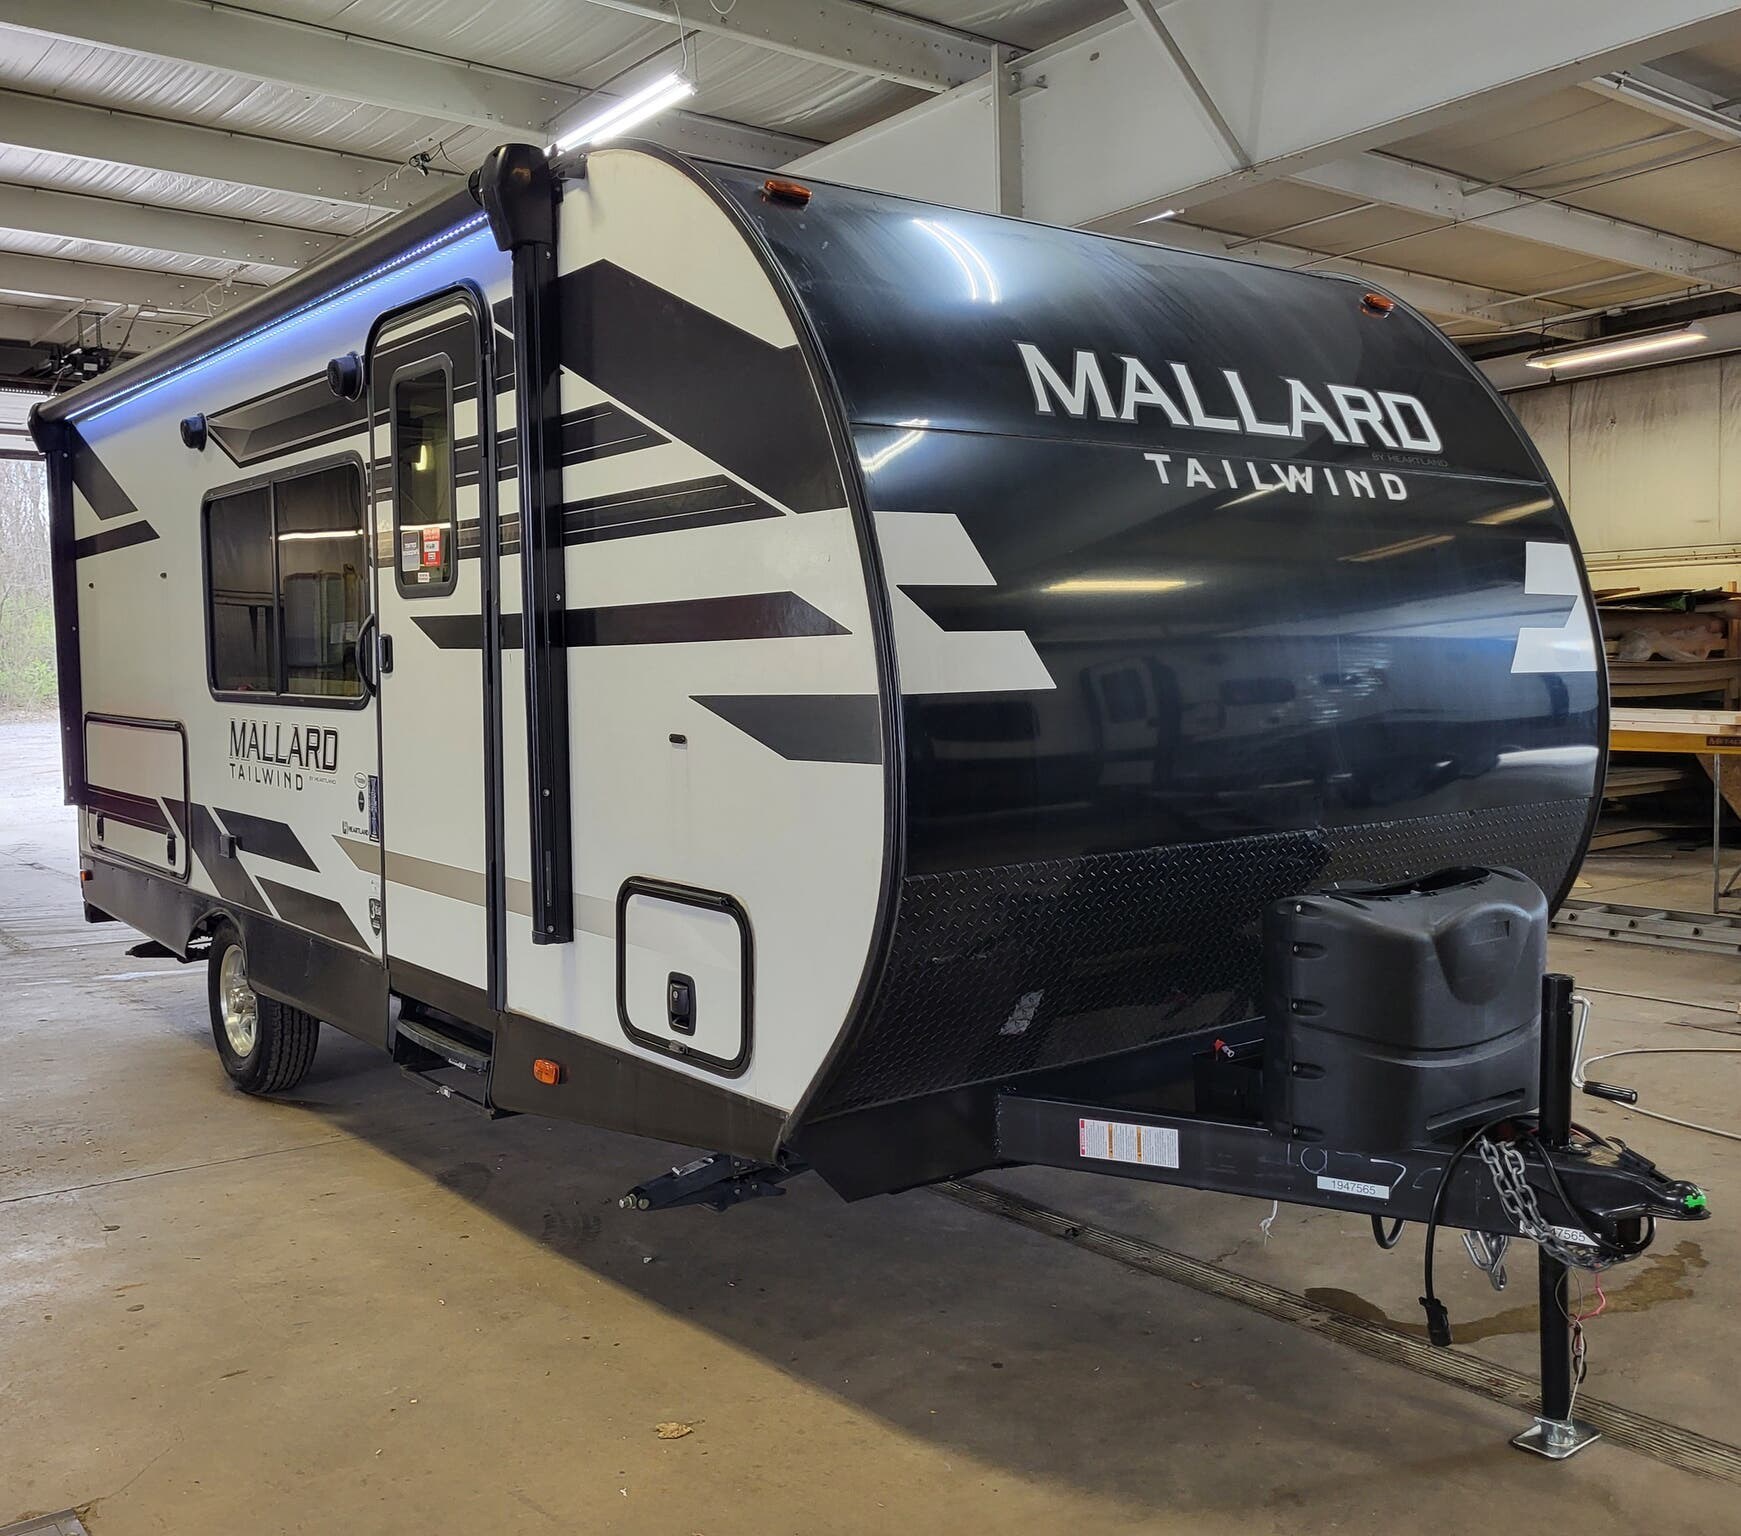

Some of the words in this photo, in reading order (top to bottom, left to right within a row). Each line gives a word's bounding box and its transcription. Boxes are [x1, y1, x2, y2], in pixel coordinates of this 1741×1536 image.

[1014, 341, 1443, 453] MALLARD
[1144, 453, 1407, 501] TAILWIND
[229, 718, 339, 774] MALLARD
[229, 763, 304, 791] TAILWIND
[1331, 1180, 1376, 1195] 1947565
